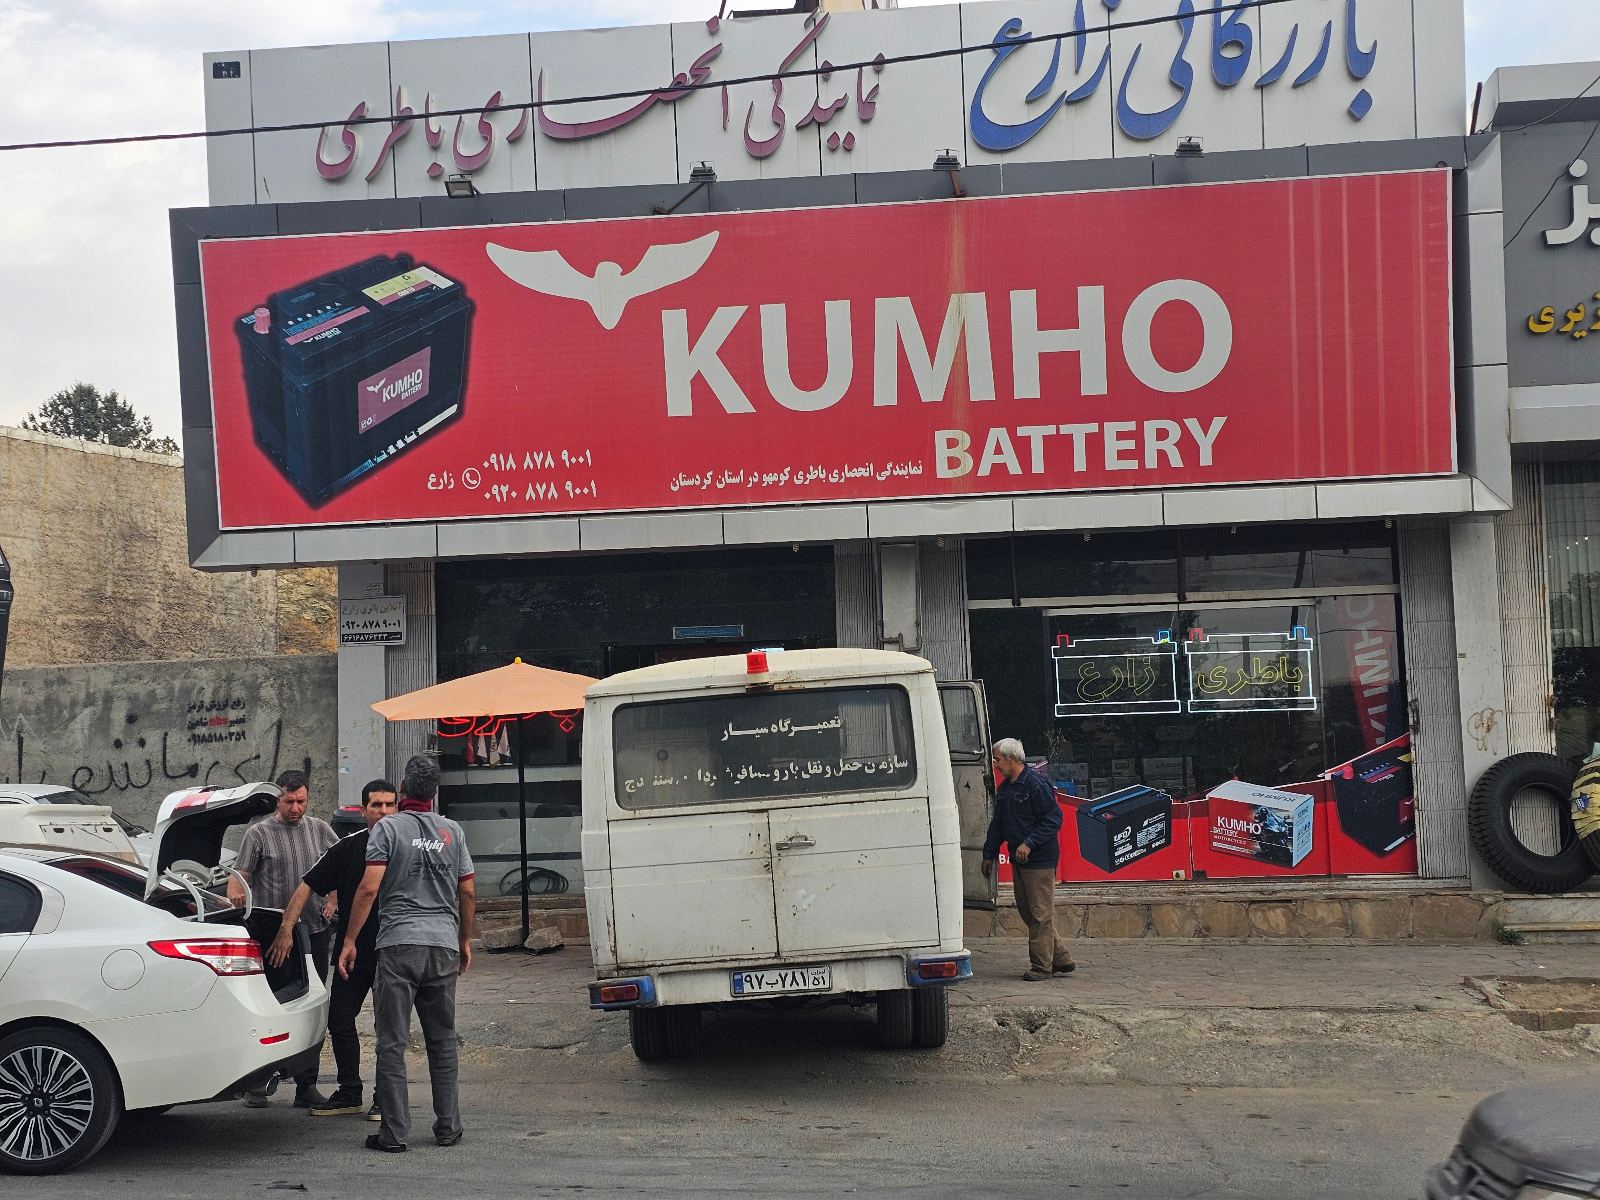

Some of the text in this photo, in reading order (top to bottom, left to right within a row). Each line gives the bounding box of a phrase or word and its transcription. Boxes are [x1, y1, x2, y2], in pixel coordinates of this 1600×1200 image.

[314, 85, 446, 181] باطری
[661, 279, 1233, 417] KUMHO
[382, 368, 422, 403] KUMHO
[934, 416, 1228, 478] BATTERY
[483, 449, 592, 471] ۰۹۱۸ ۸۷۸ ۹۰۰۱
[427, 470, 454, 490] زارع
[670, 460, 923, 491] نمایندگی انحصاری باطری کومهو در استان کردستان
[484, 480, 597, 502] ۰۹۲۰ ۸۷۸ ۹۰۰۱
[362, 620, 380, 629] ۸۷۸
[382, 619, 401, 629] ۹۰۰۱
[1076, 656, 1303, 702] باطری زارع
[772, 767, 780, 783] و
[802, 760, 824, 779] نقل
[825, 765, 832, 778] و
[834, 758, 862, 777] حمل
[1217, 816, 1262, 836] KUMHO
[812, 975, 826, 986] ۵۱
